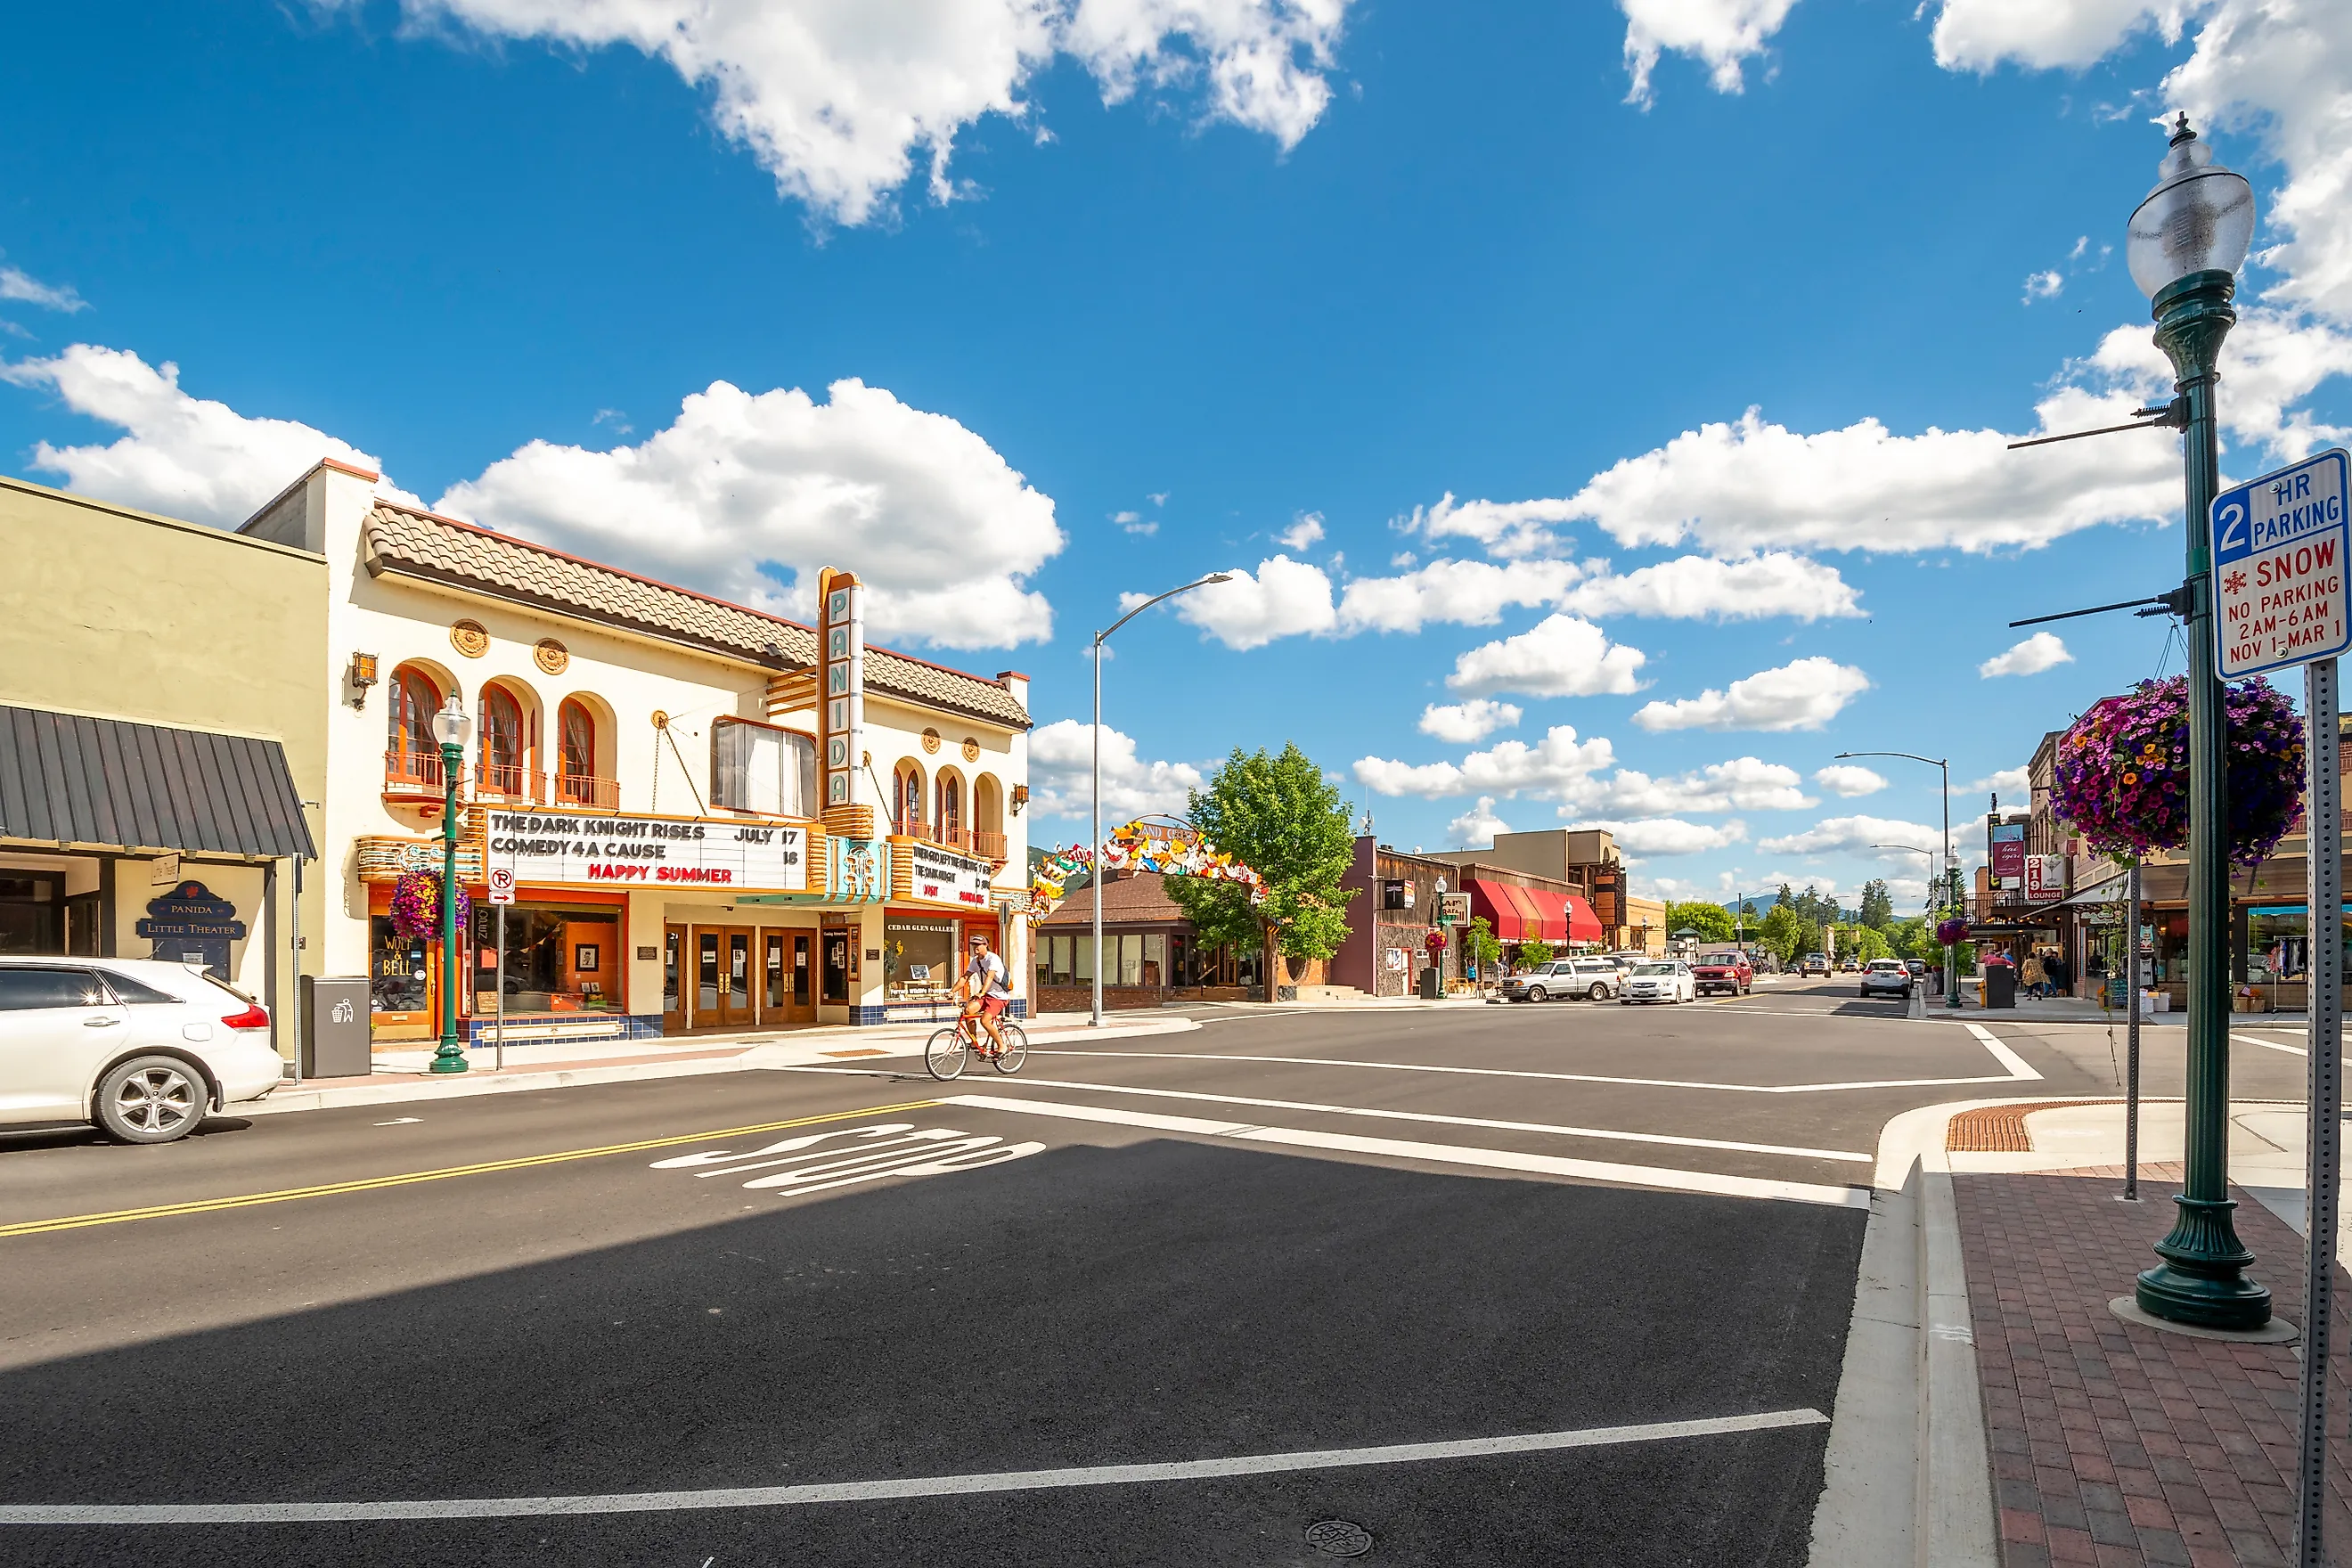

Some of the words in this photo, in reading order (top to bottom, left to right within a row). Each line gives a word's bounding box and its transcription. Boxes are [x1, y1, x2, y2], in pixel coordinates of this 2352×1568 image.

[2277, 473, 2311, 506] HR
[2218, 502, 2246, 552] 2
[2254, 495, 2339, 547] PARKING
[2257, 538, 2336, 588] SNOW
[2228, 602, 2250, 623] NO
[2261, 576, 2339, 613] PARKING
[2230, 641, 2262, 663] NOV
[2334, 619, 2340, 637] 1
[831, 592, 846, 802] PANIDA
[491, 814, 527, 831] THE
[528, 817, 579, 834] DARK
[584, 820, 649, 837] KNIGHT
[651, 824, 705, 840] RISES
[734, 829, 773, 845] JULY
[781, 831, 797, 845] 17
[491, 837, 571, 856] COMEDY
[571, 841, 584, 856] 4
[585, 842, 600, 857] A
[604, 843, 666, 860] CAUSE
[588, 863, 649, 880] HAPPY
[657, 867, 732, 883] SUMMER
[2029, 858, 2040, 890] 219
[171, 905, 213, 914] PANIDA
[478, 910, 488, 940] OPEN
[147, 923, 184, 934] LITTLE
[188, 924, 236, 935] THEATER
[384, 935, 413, 951] WOLF
[383, 960, 412, 976] BELL
[394, 951, 402, 960] &
